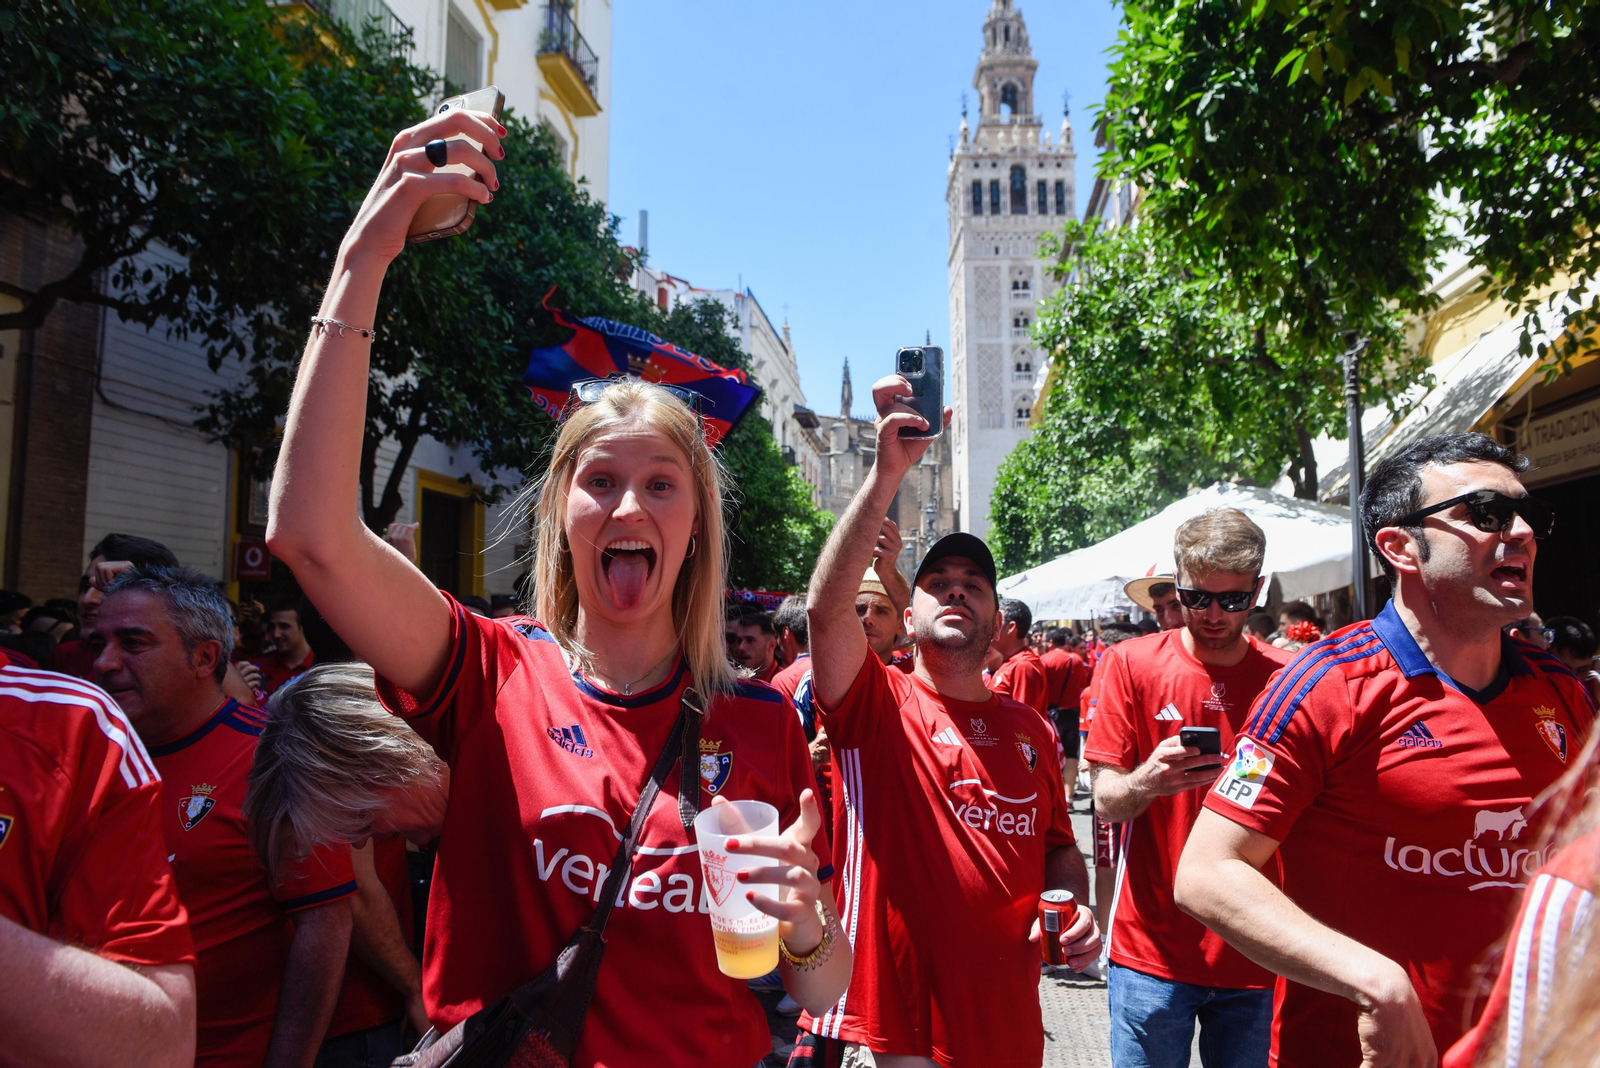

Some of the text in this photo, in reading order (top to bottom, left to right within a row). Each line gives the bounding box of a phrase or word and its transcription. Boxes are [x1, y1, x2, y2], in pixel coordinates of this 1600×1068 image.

[547, 727, 594, 758] adidas
[1398, 737, 1443, 748] adidas
[1218, 776, 1253, 801] LFP
